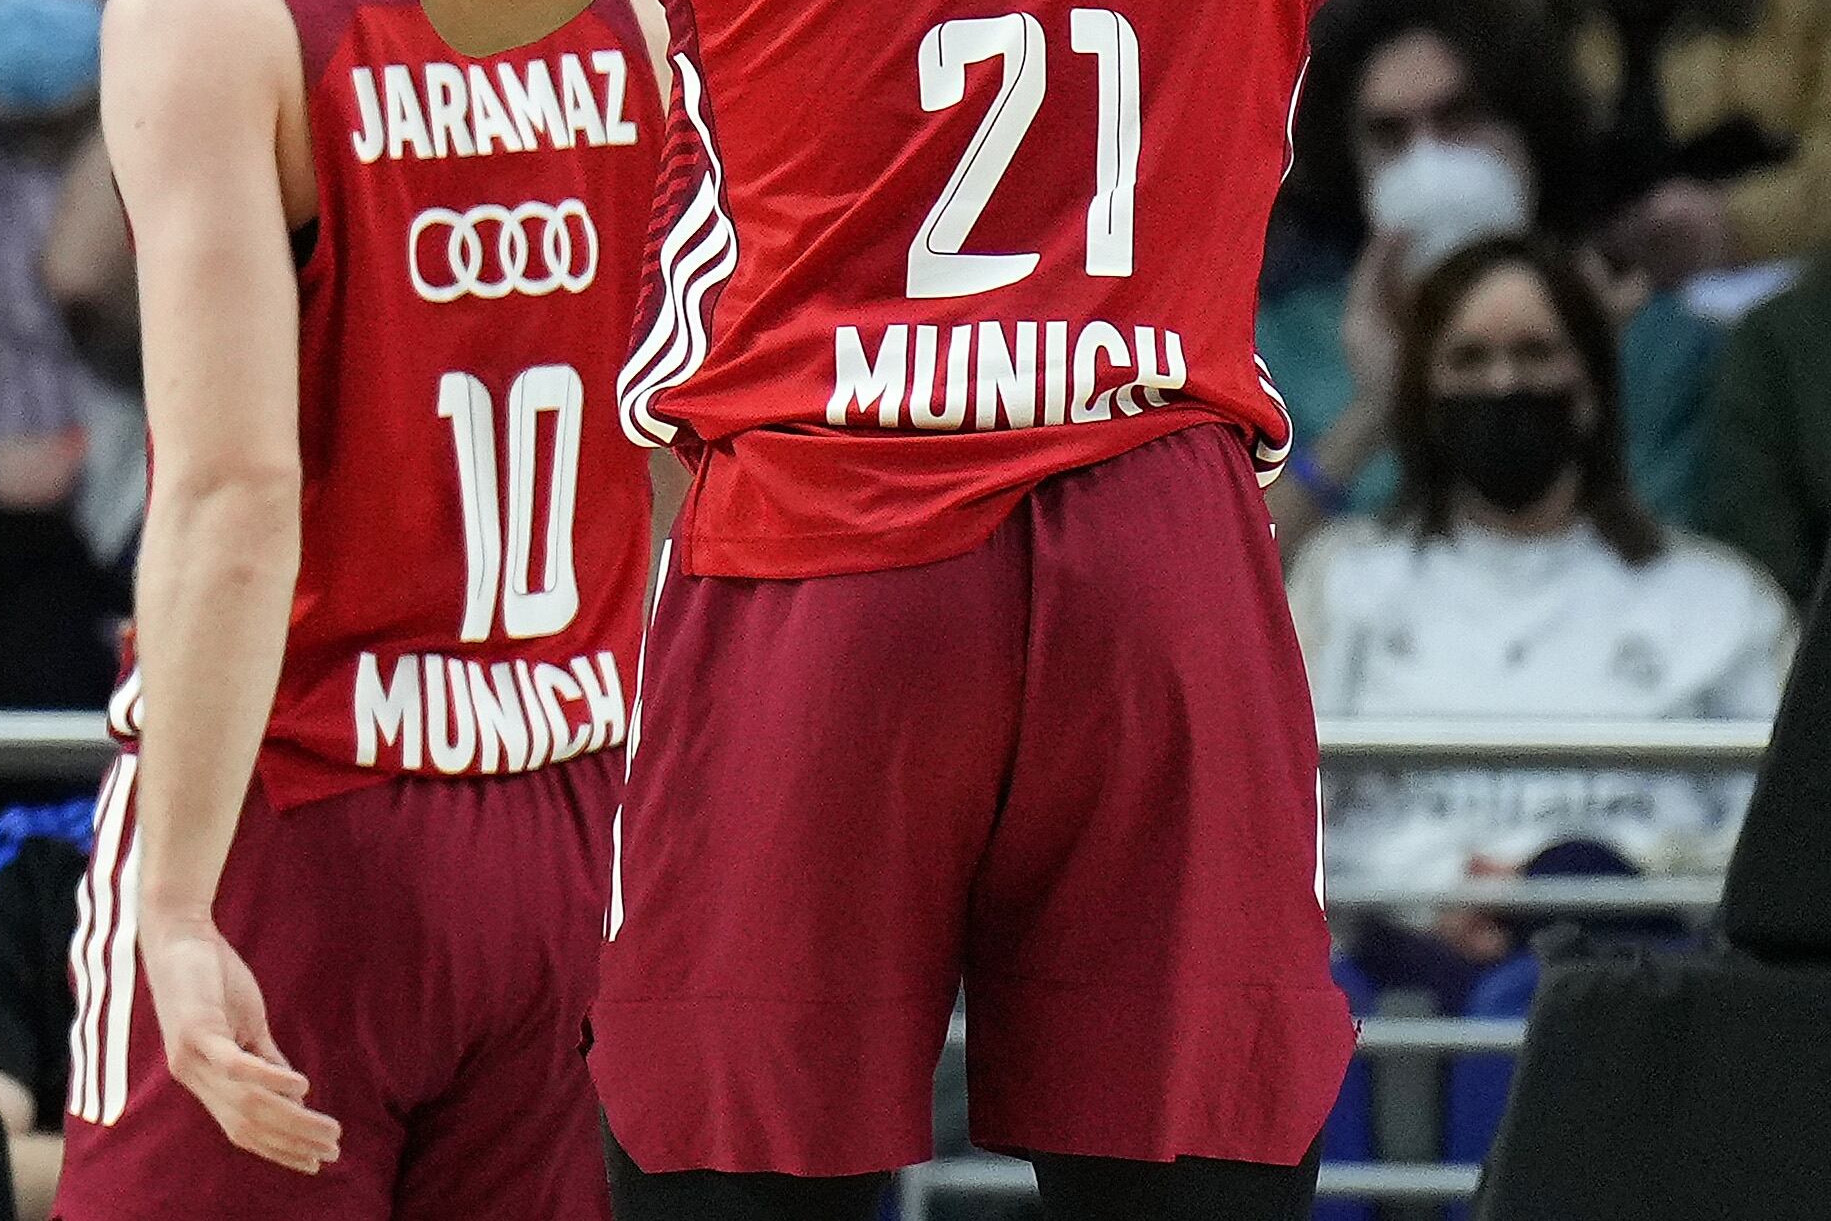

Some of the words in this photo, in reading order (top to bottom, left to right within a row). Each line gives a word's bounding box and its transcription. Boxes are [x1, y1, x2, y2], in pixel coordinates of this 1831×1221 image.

[351, 49, 639, 164] JARAMAZ
[906, 8, 1142, 298] 21
[826, 319, 1187, 431] MUNICH
[437, 363, 584, 644] 10
[354, 650, 626, 776] MUNICH
